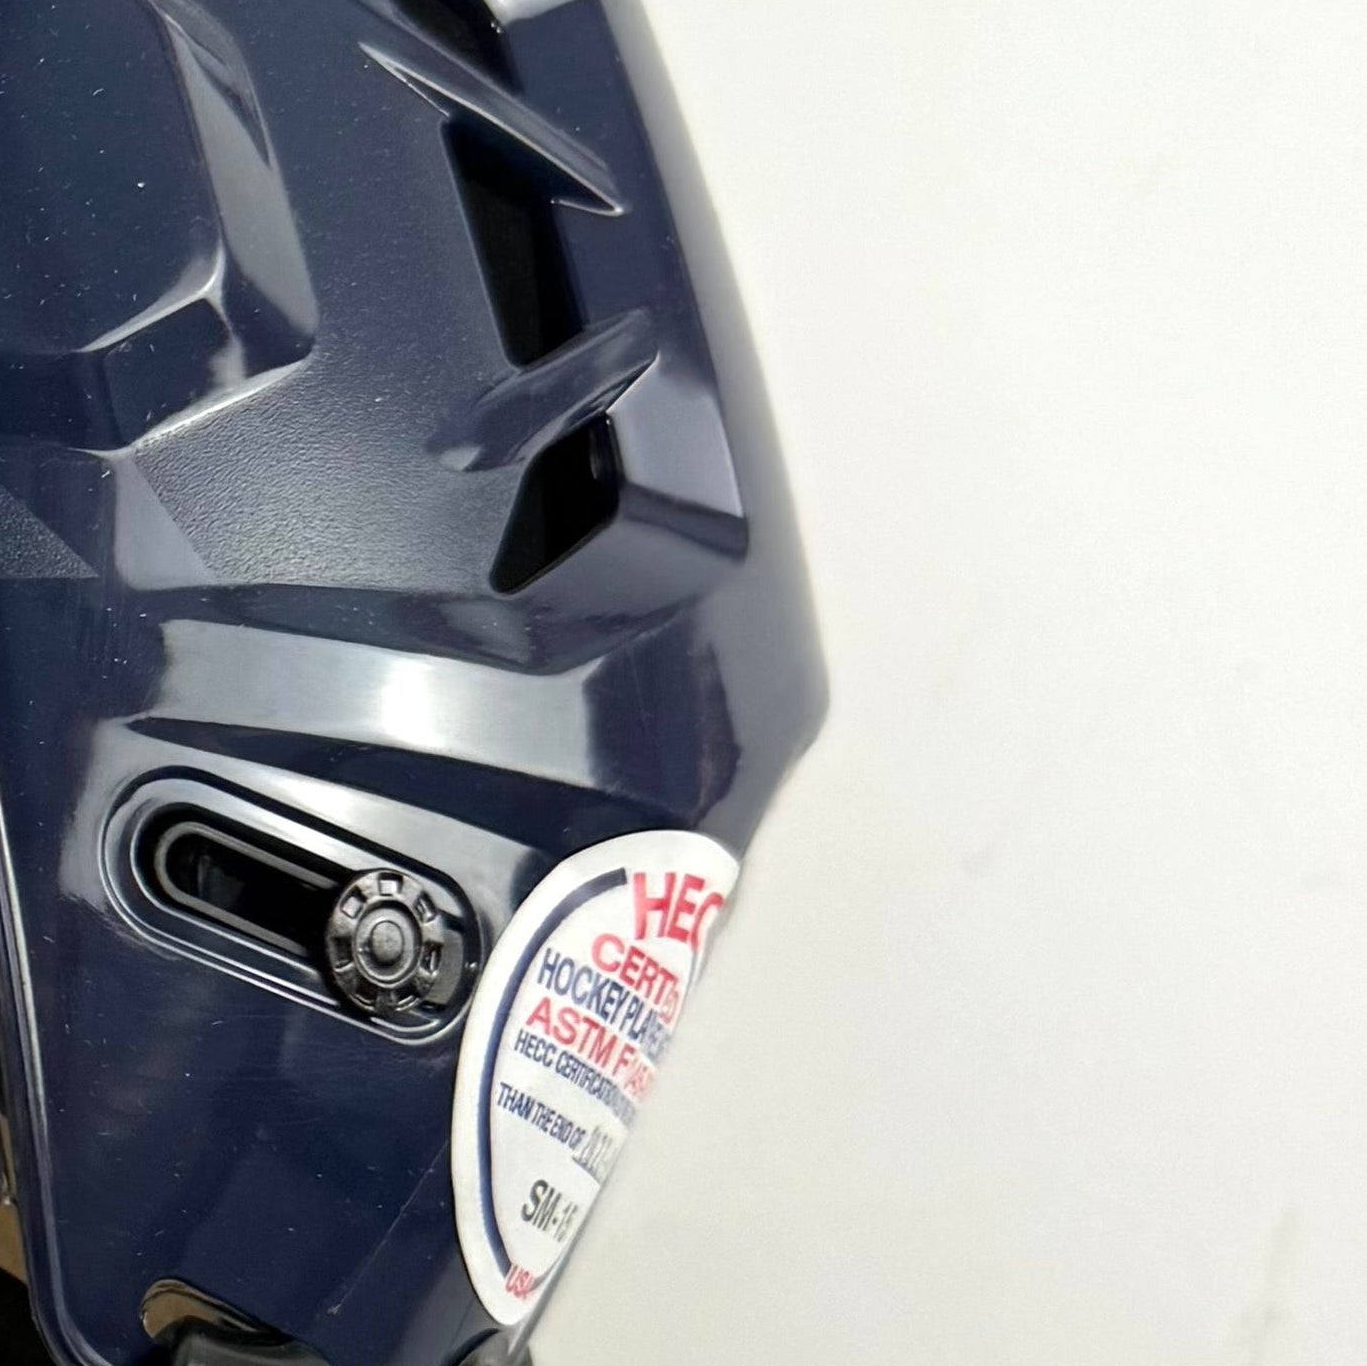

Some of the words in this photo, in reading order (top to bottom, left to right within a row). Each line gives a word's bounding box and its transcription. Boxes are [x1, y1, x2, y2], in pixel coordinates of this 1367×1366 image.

[537, 947, 627, 1021] HOCKEY
[513, 1030, 558, 1070] HECC
[526, 998, 617, 1069] ASTM
[496, 1082, 535, 1124] THAN
